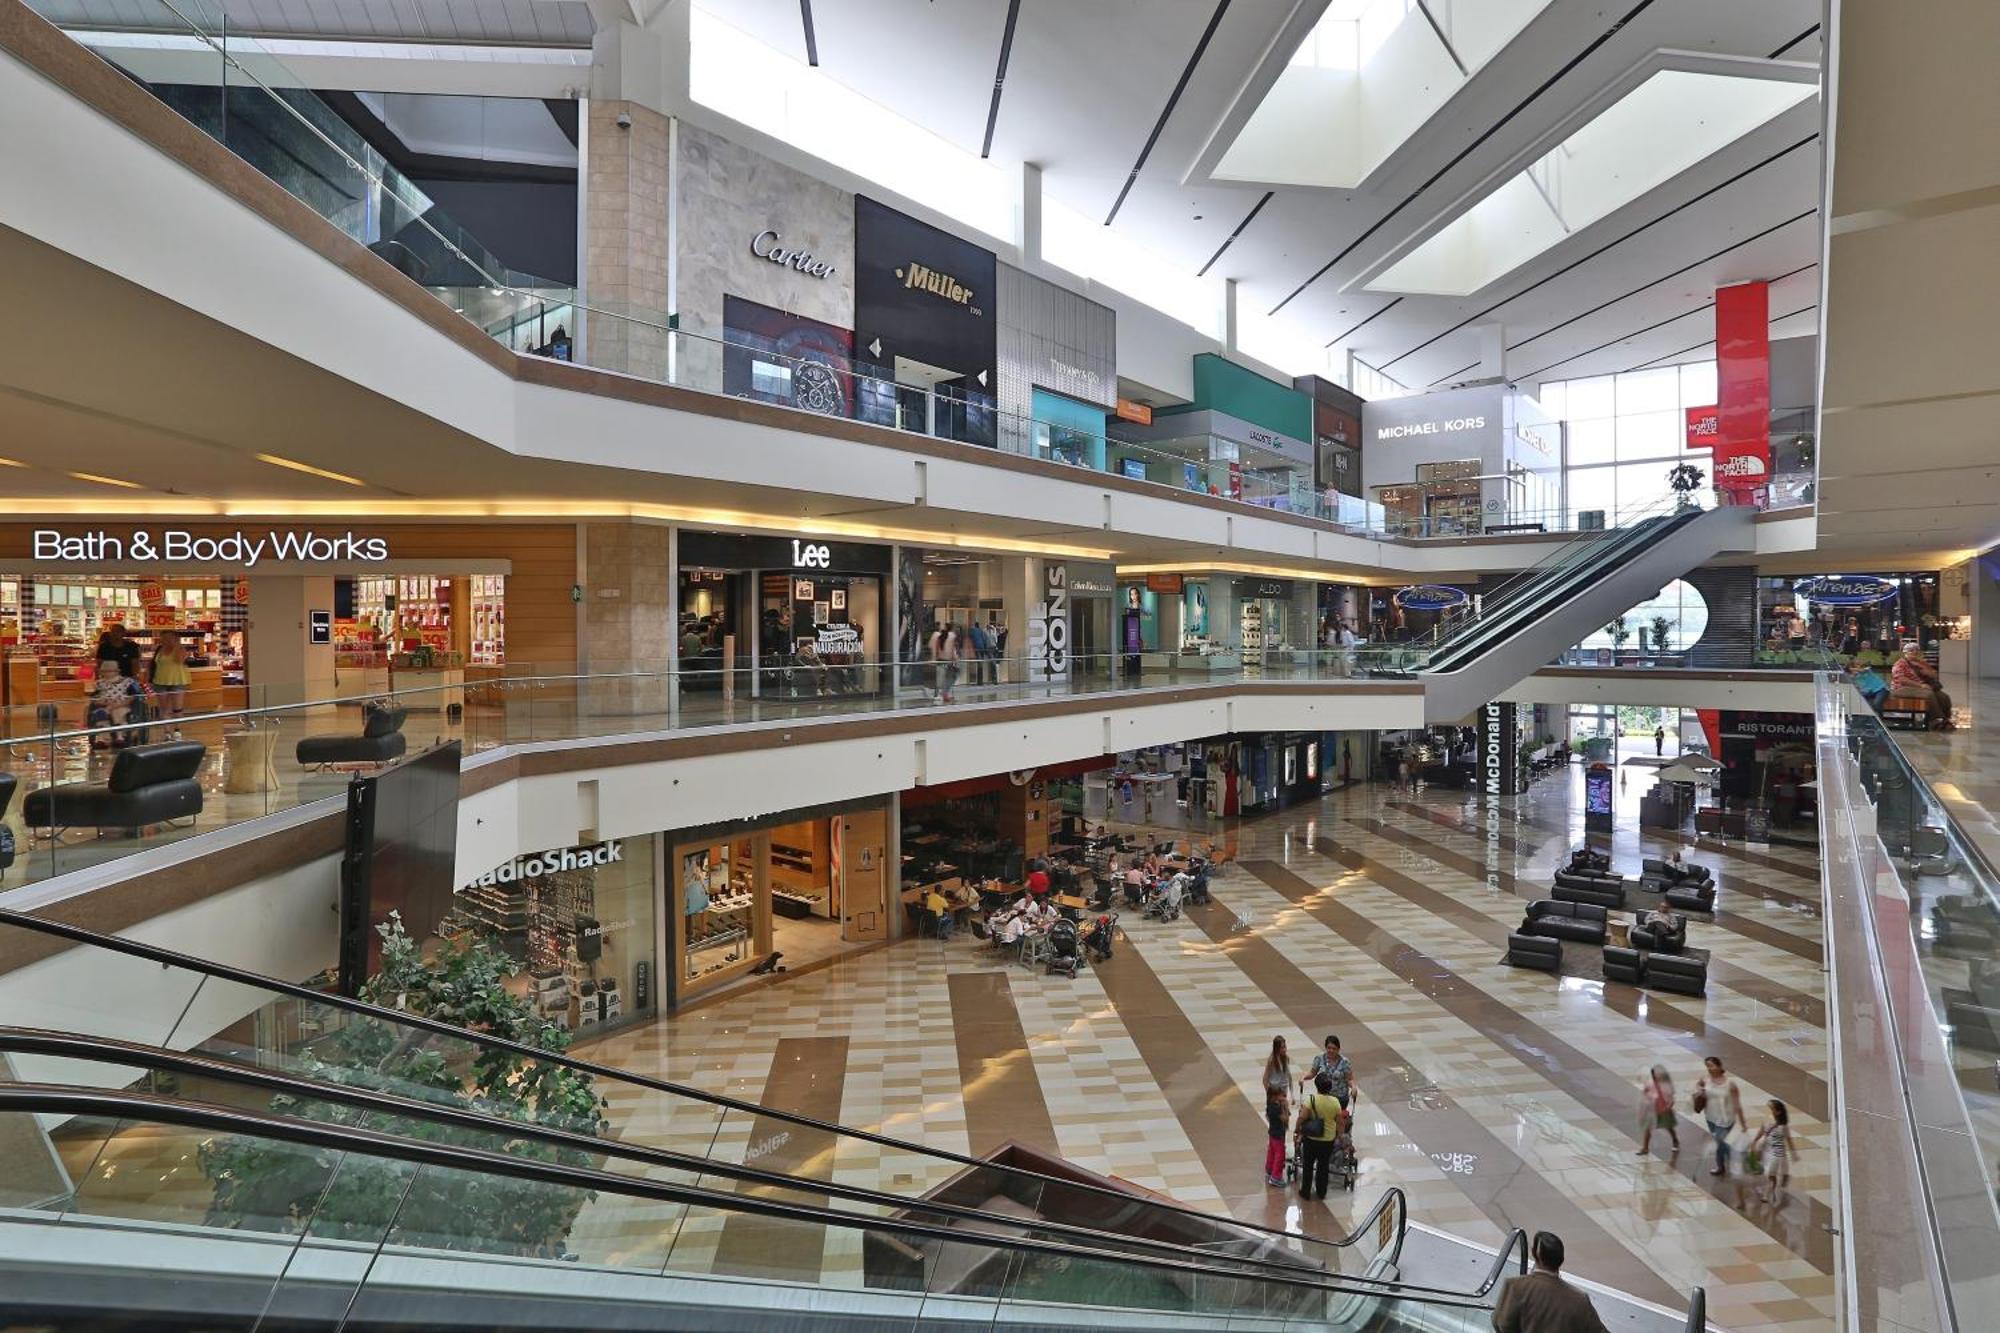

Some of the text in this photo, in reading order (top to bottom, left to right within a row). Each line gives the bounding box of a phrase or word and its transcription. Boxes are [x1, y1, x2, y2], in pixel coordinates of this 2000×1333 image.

[752, 230, 837, 279] Cartier
[905, 262, 973, 304] Müller
[1378, 416, 1485, 440] MICHAEL KORS
[1689, 423, 1717, 431] NORTH
[1701, 416, 1717, 424] THE
[1715, 463, 1748, 471] NORTH
[34, 530, 388, 566] Bath & Body Works
[792, 539, 830, 568] Lee
[1258, 583, 1281, 595] ALDO
[1048, 566, 1067, 682] ICONS
[1028, 602, 1048, 683] TRUE
[1737, 722, 1816, 736] RISTORANT
[1486, 700, 1500, 794] McDonald'
[465, 840, 624, 888] adioShack
